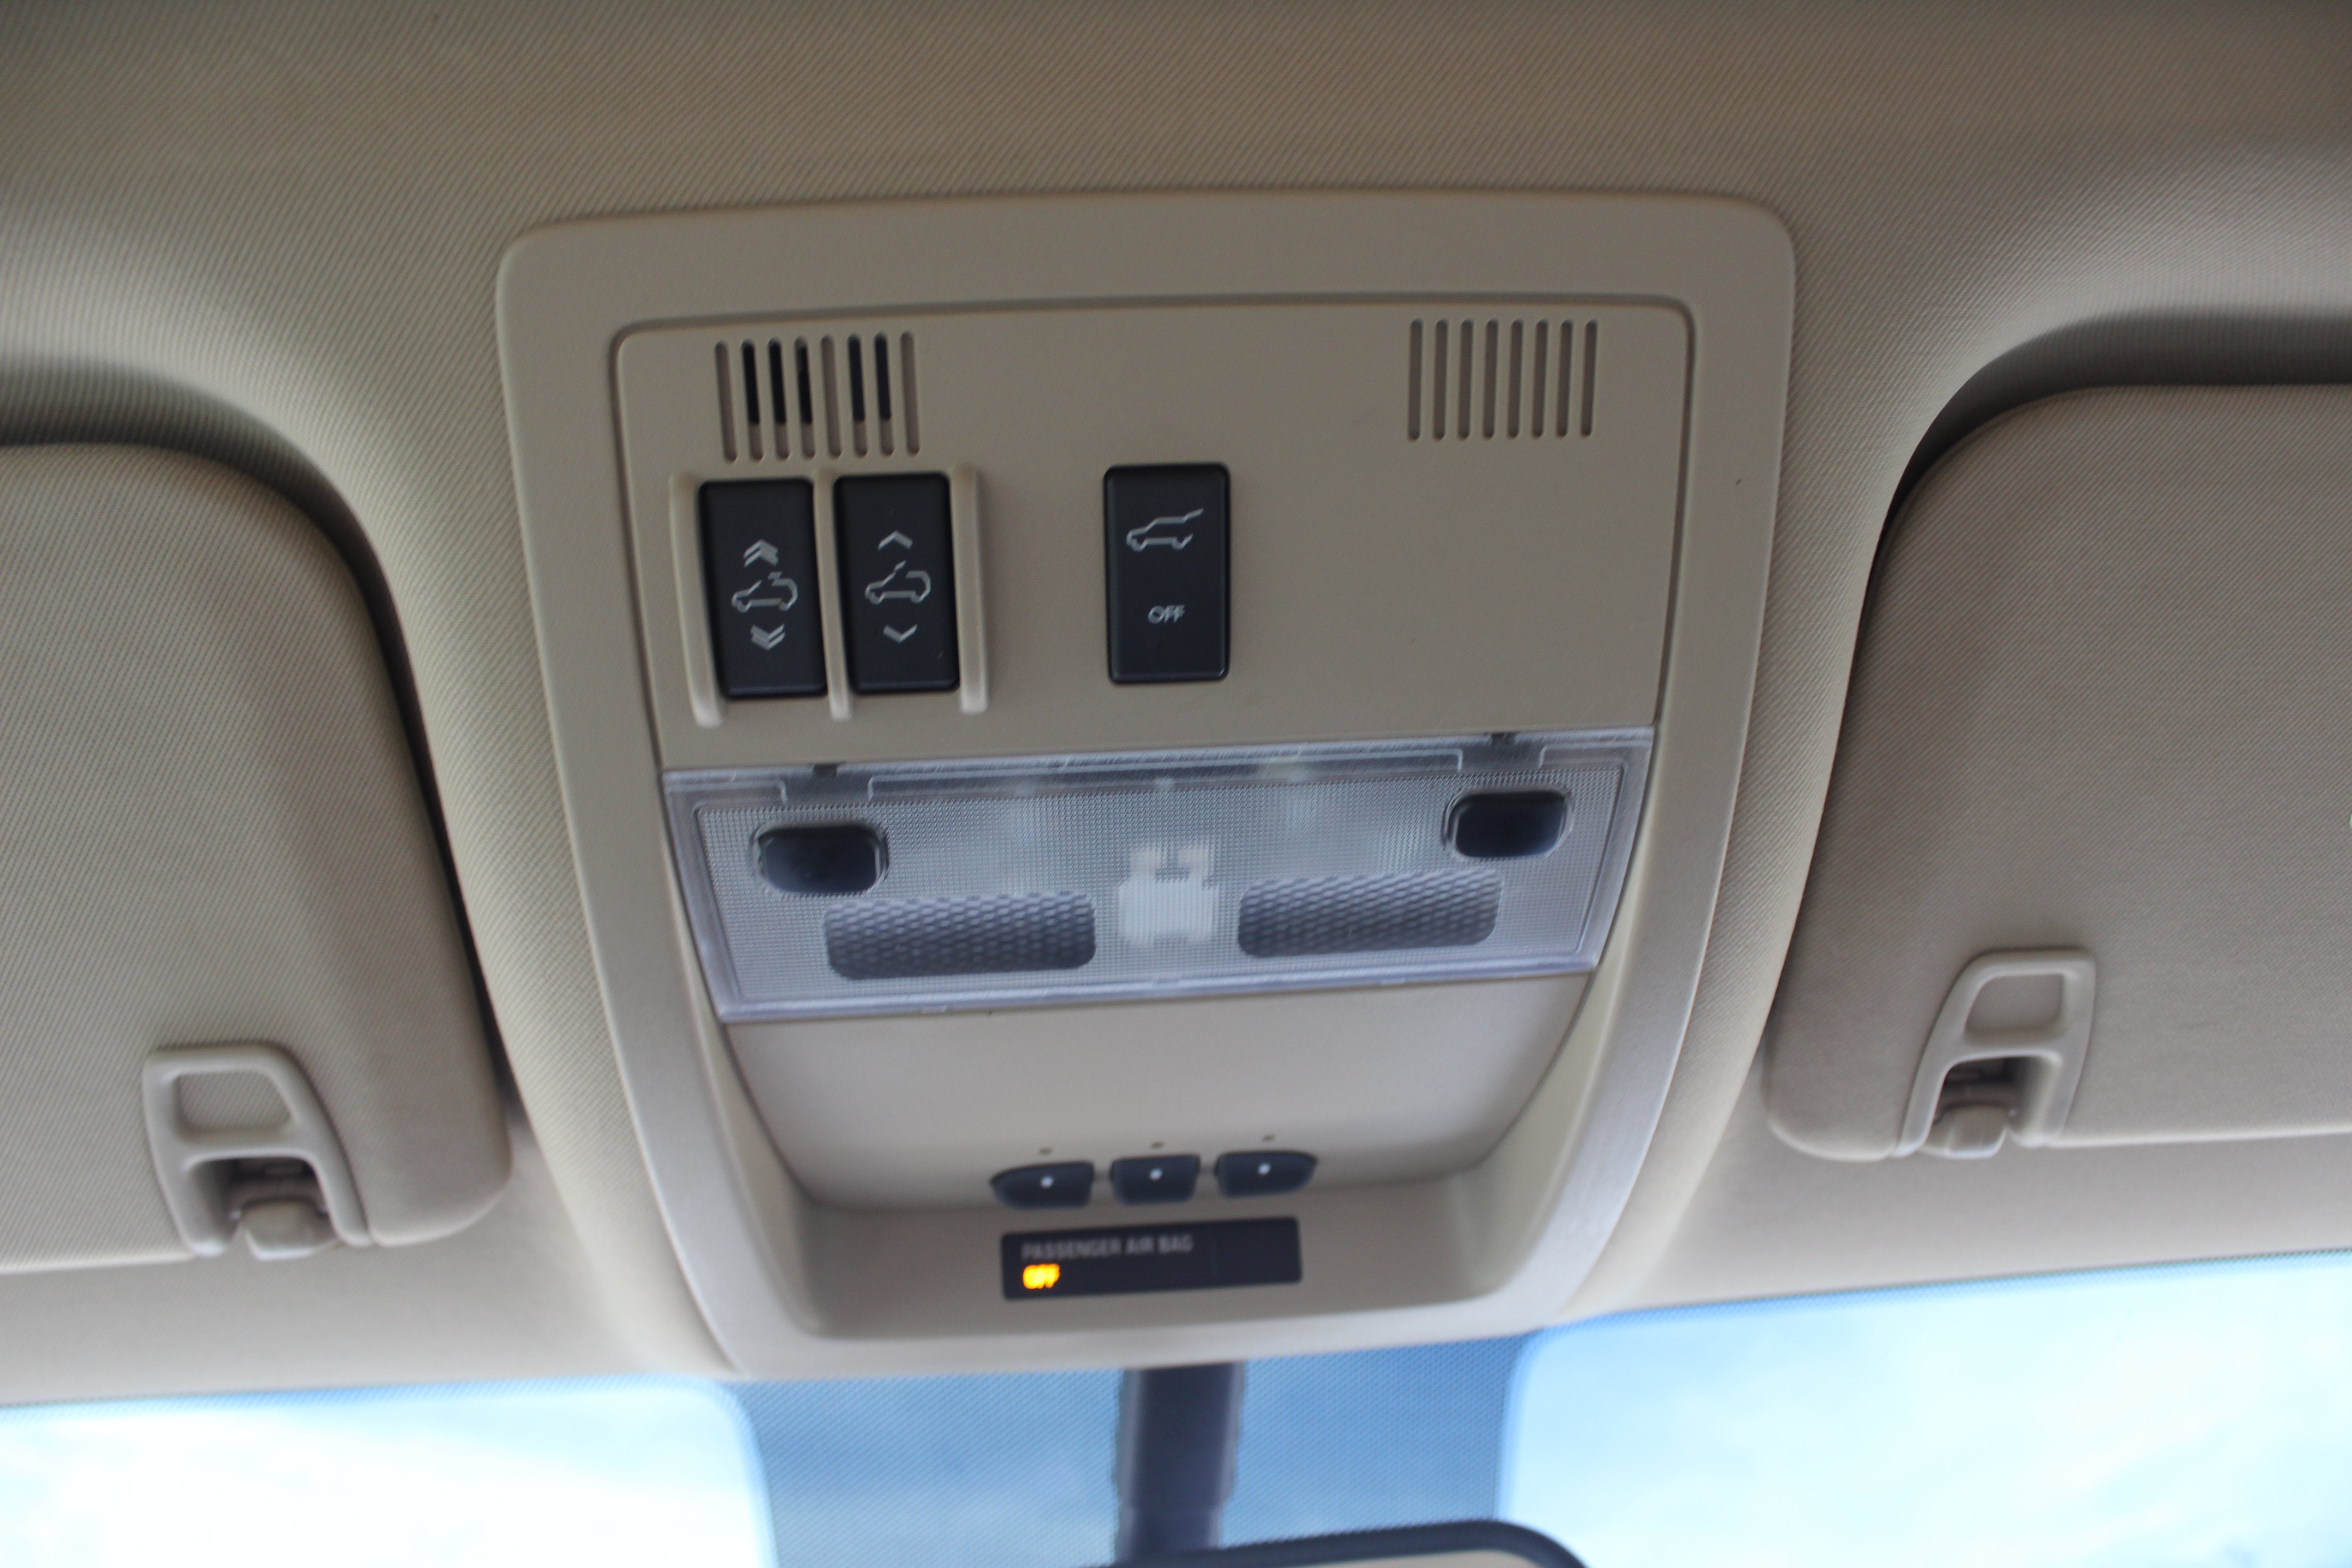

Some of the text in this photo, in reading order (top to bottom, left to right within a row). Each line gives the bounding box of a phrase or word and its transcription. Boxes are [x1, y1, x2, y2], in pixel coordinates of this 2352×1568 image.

[1147, 605, 1185, 624] OFF
[1021, 1233, 1193, 1260] PASSENGER AIR BAG
